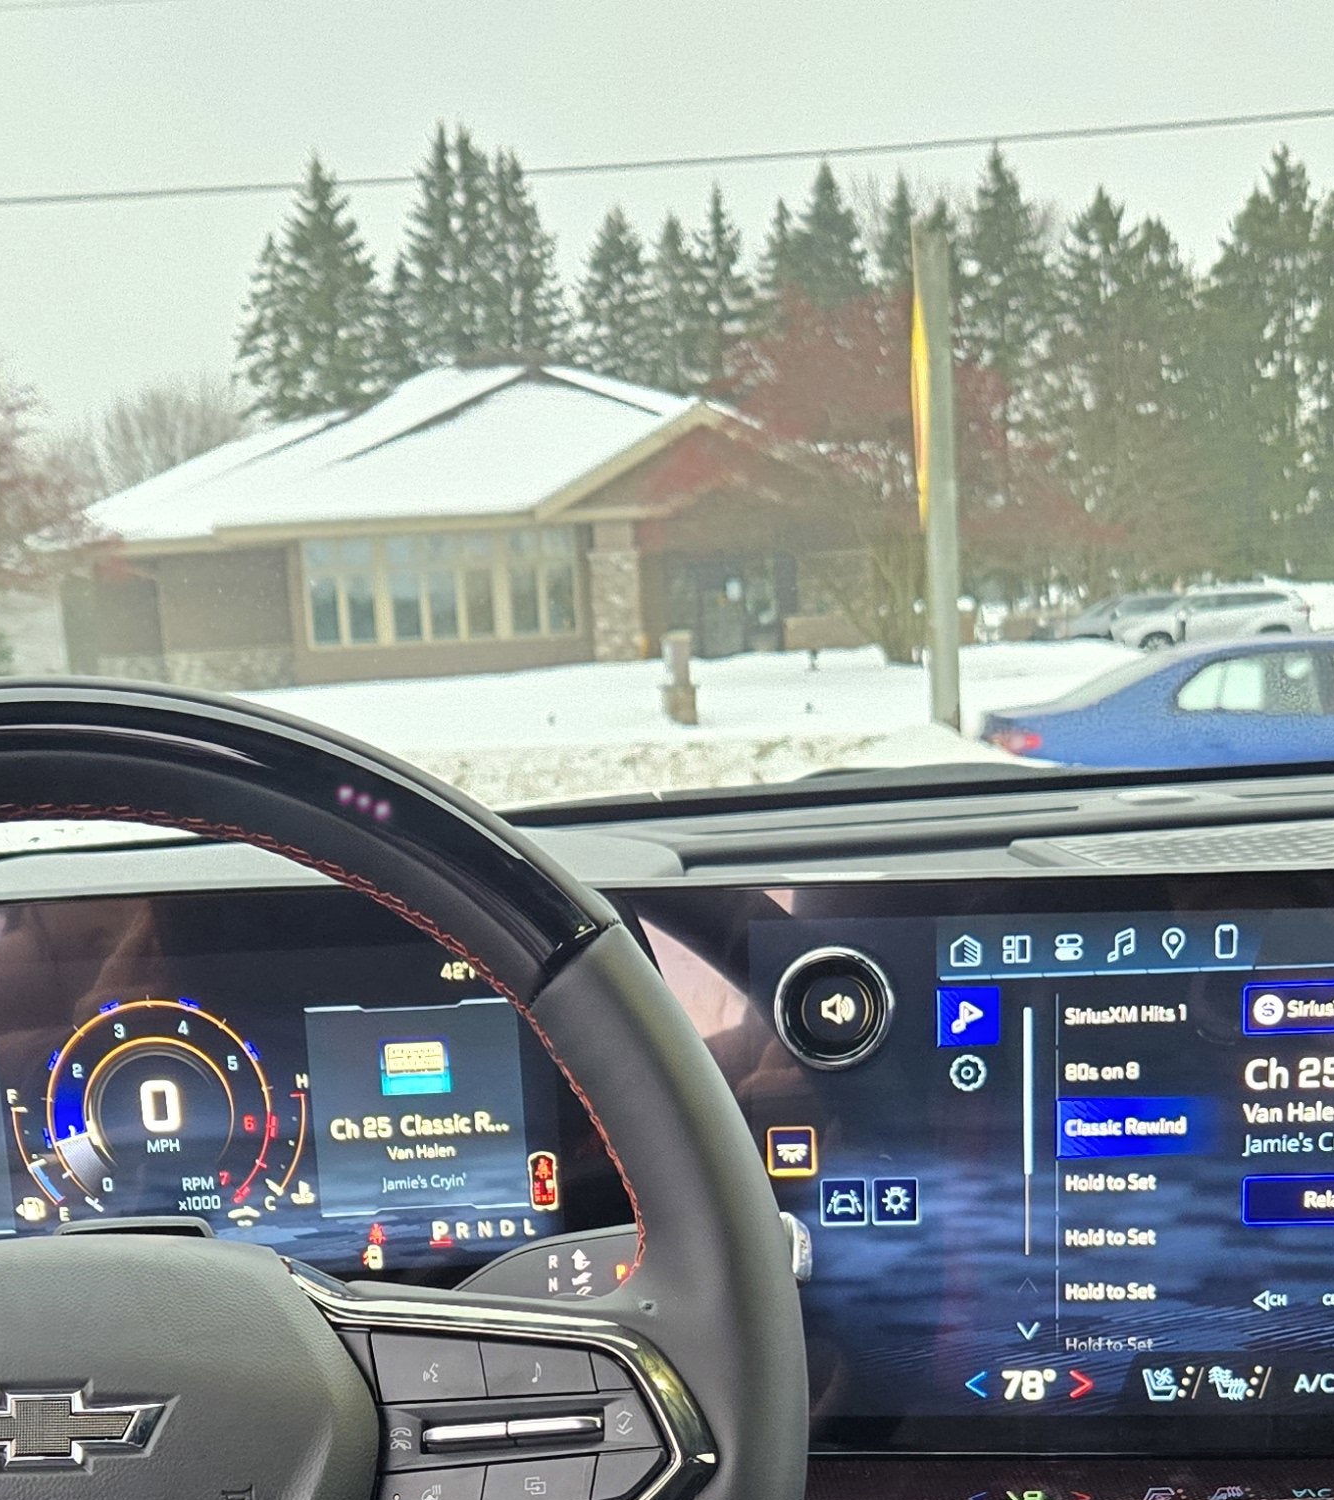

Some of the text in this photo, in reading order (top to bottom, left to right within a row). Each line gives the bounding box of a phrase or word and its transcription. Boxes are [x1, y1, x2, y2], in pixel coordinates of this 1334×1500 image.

[1064, 1003, 1188, 1025] SiriusXM Hits 1
[113, 1023, 127, 1038] 3
[178, 1020, 190, 1036] 4
[72, 1063, 84, 1079] 2
[227, 1055, 239, 1071] 5
[1099, 1066, 1122, 1081] on
[1125, 1062, 1141, 1079] 8
[295, 1074, 309, 1090] H
[1244, 1058, 1290, 1090] Ch
[140, 1079, 182, 1133] 0
[1243, 1103, 1283, 1124] Van
[244, 1115, 256, 1131] 6
[330, 1111, 510, 1140] Ch 25 Classic R...
[1064, 1115, 1188, 1137] Classic Rewind
[146, 1138, 181, 1154] MPH
[387, 1143, 456, 1161] Van Halen
[1242, 1132, 1314, 1157] Jamie's
[102, 1177, 114, 1192] 0
[182, 1176, 215, 1191] RPM
[1064, 1172, 1157, 1194] Hold to Set
[178, 1195, 221, 1211] x1000
[264, 1196, 277, 1211] C
[432, 1219, 536, 1240] P R N D L
[1064, 1227, 1157, 1248] Hold to Set
[1064, 1282, 1157, 1302] Hold to Set
[1000, 1369, 1057, 1402] 78°
